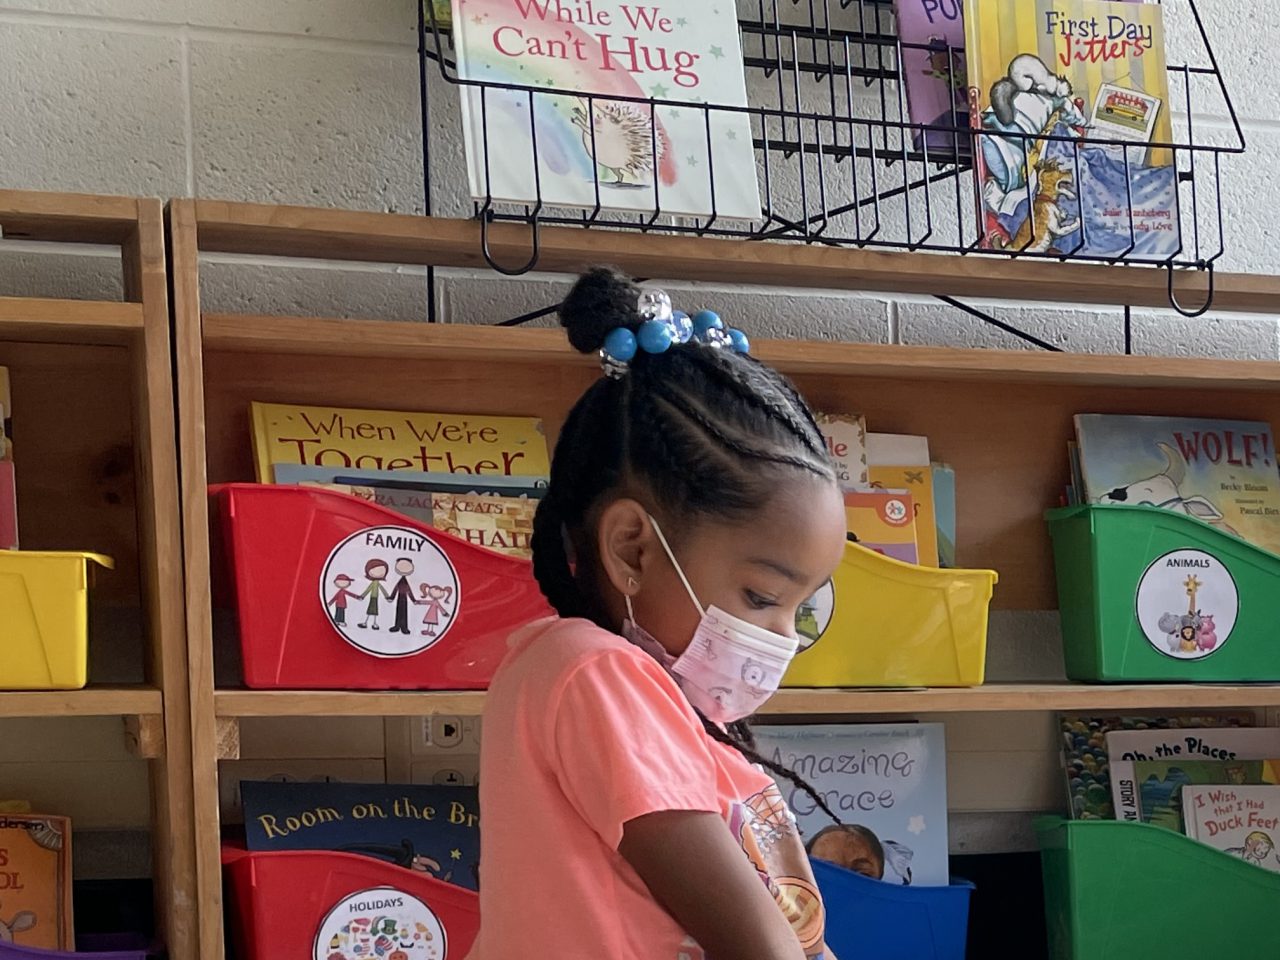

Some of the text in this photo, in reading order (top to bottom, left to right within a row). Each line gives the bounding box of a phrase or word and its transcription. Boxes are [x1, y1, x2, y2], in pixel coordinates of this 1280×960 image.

[512, 0, 674, 33] While We
[1045, 12, 1153, 46] First Day
[493, 26, 700, 88] Can't Hug
[1059, 34, 1146, 66] Jitters
[299, 412, 499, 444] When We're
[1173, 431, 1270, 467] WOLF!
[451, 500, 503, 514] KEATS
[366, 533, 425, 552] FAMILY
[1166, 558, 1210, 568] ANIMALS
[772, 747, 915, 779] Amazing
[1155, 743, 1182, 757] the
[1185, 737, 1237, 761] Places
[789, 789, 895, 816] Grace
[1120, 779, 1136, 808] STORY
[1194, 790, 1237, 809] I Wish
[257, 807, 343, 839] Room
[352, 802, 387, 819] on
[393, 797, 436, 820] the
[1214, 800, 1264, 817] that I Had
[1204, 815, 1243, 836] Duck
[1247, 812, 1279, 830] Feet
[349, 897, 403, 913] HOLIDAYS
